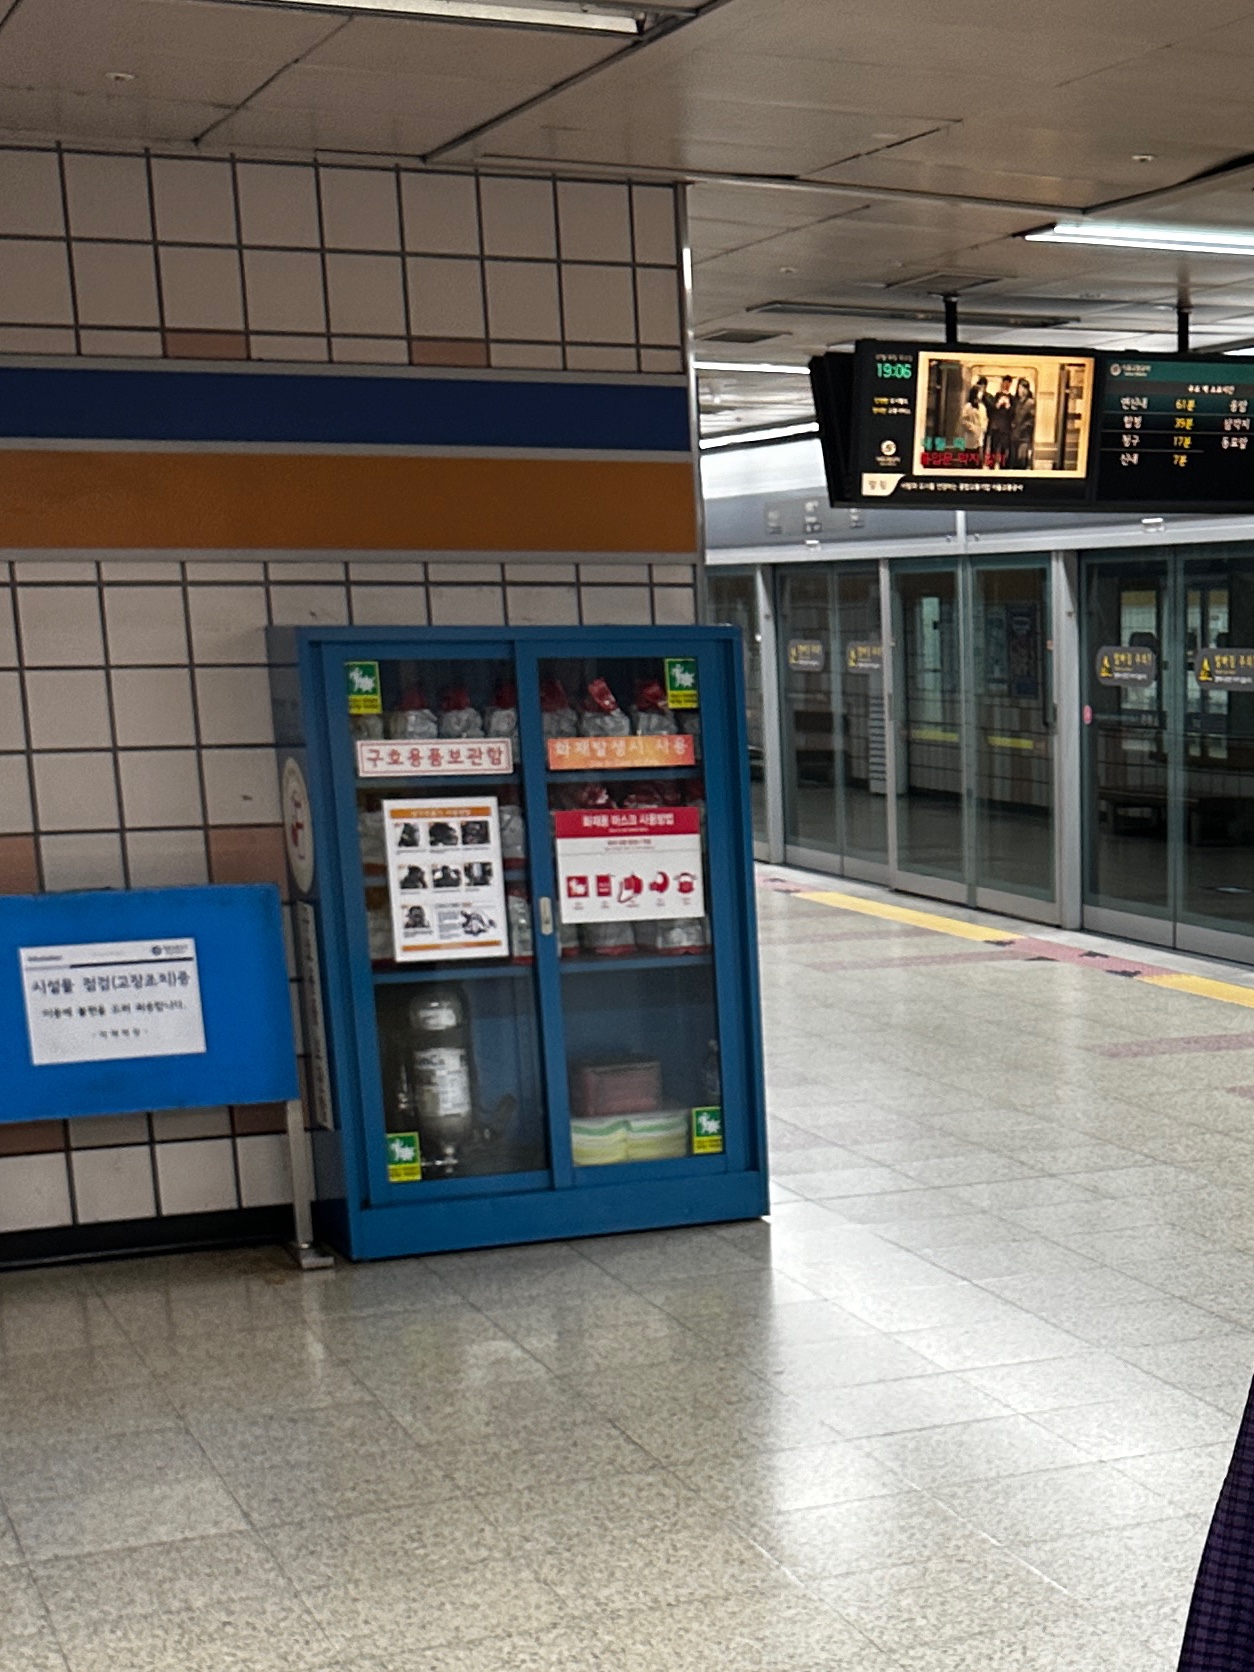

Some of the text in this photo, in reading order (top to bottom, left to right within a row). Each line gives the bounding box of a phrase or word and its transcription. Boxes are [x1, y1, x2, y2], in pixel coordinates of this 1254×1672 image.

[877, 362, 912, 379] 19:06
[367, 747, 503, 768] 구호용품보관함
[32, 976, 74, 994] 시설물
